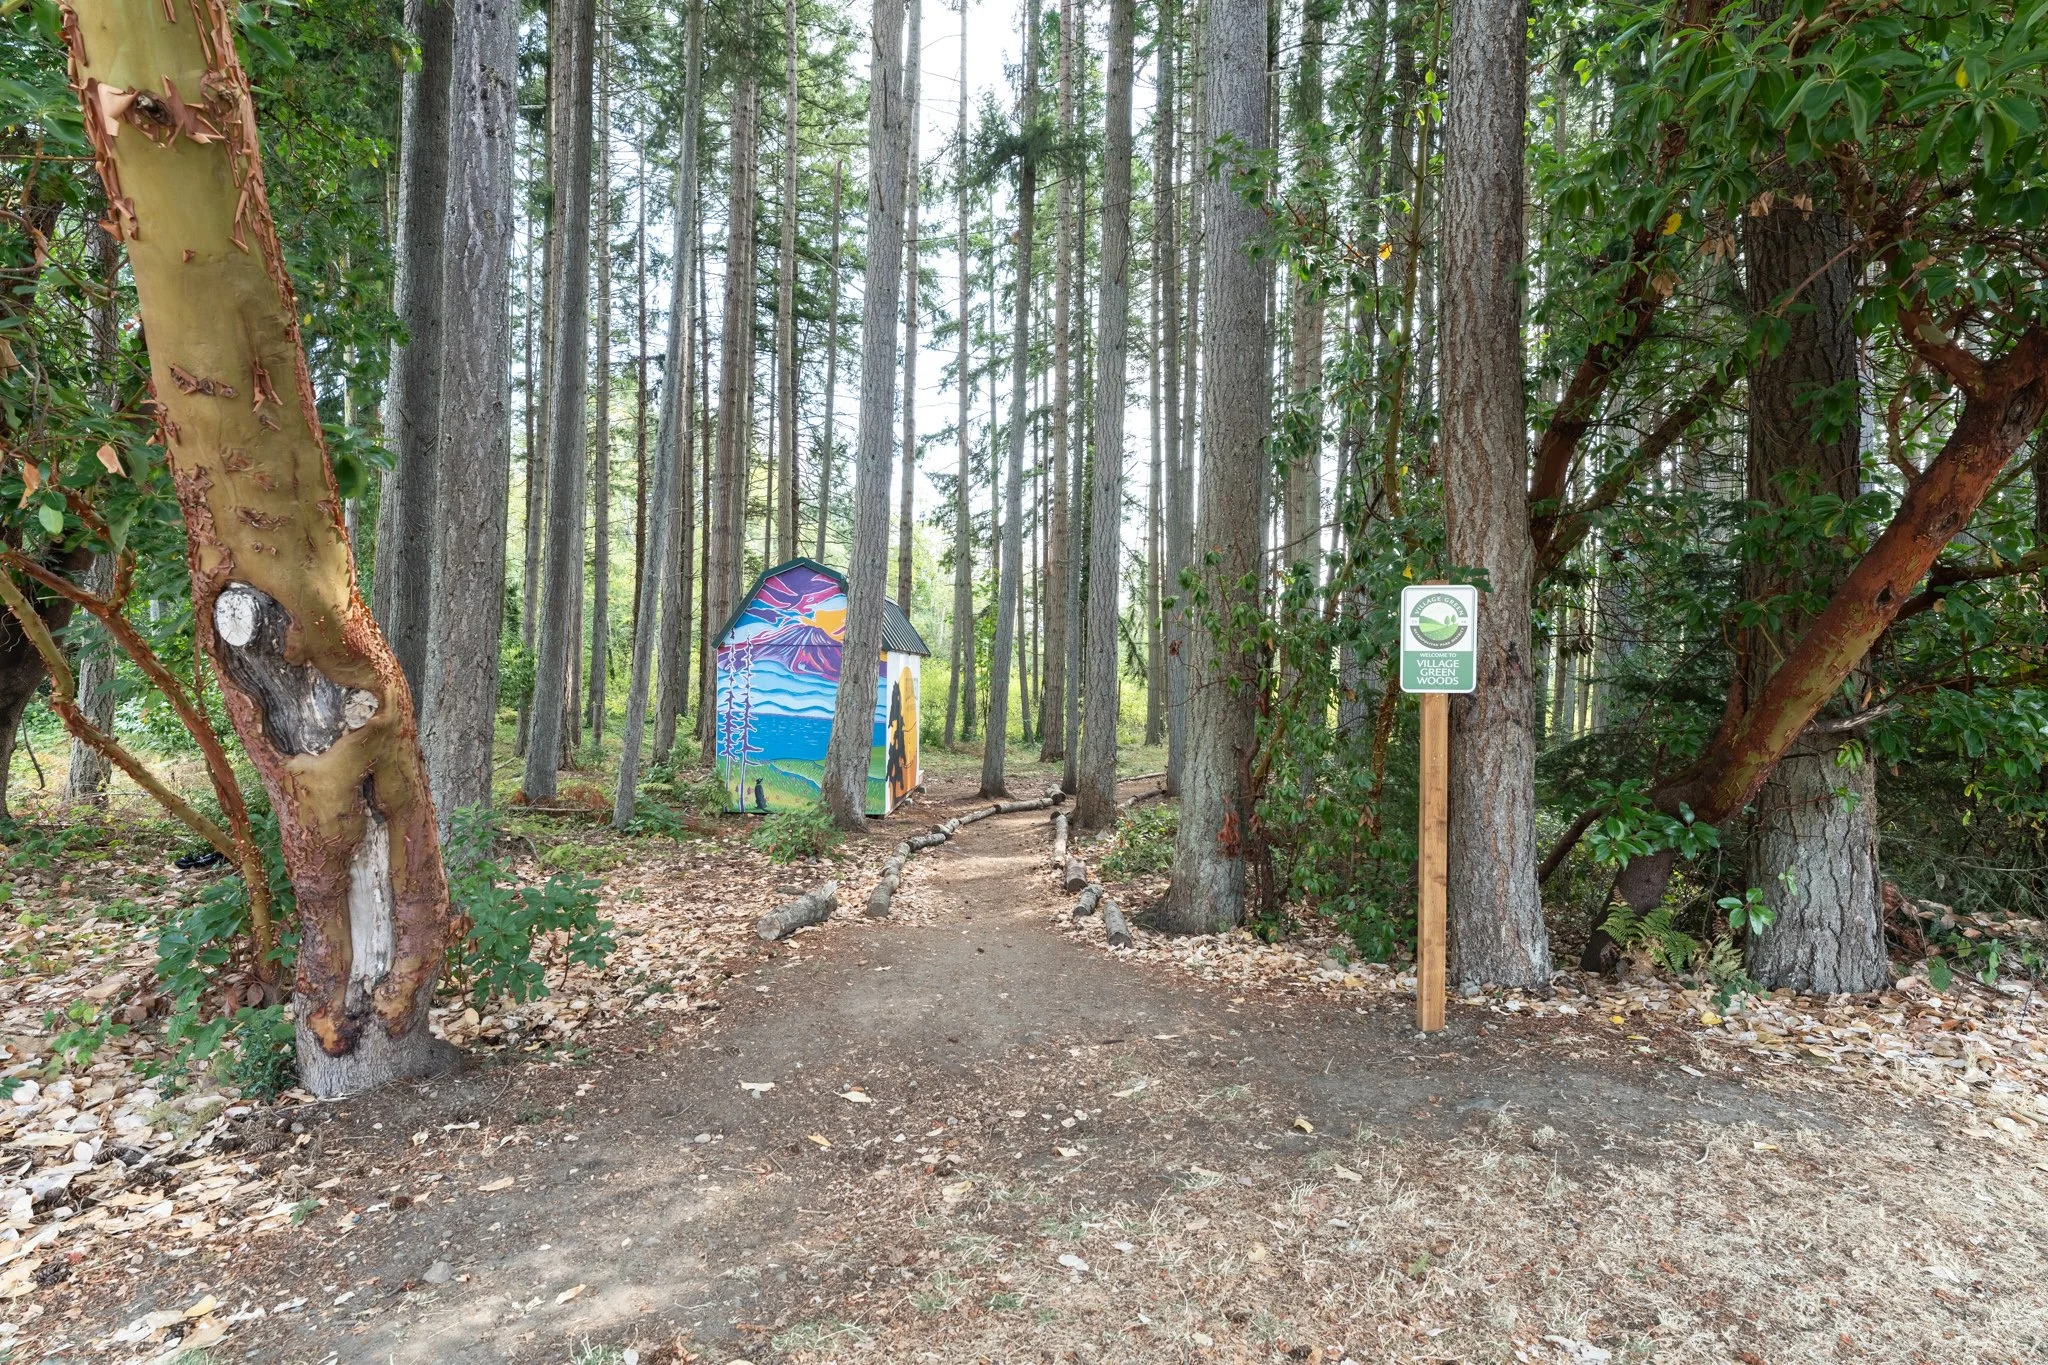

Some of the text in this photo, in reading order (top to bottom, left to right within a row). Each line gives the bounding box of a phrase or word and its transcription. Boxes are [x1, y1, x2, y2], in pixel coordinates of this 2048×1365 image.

[1414, 596, 1464, 616] VILLAGE GREEN
[1416, 660, 1460, 668] VILLAGE
[1420, 668, 1456, 676] GREEN
[1416, 676, 1459, 685] WOODS
